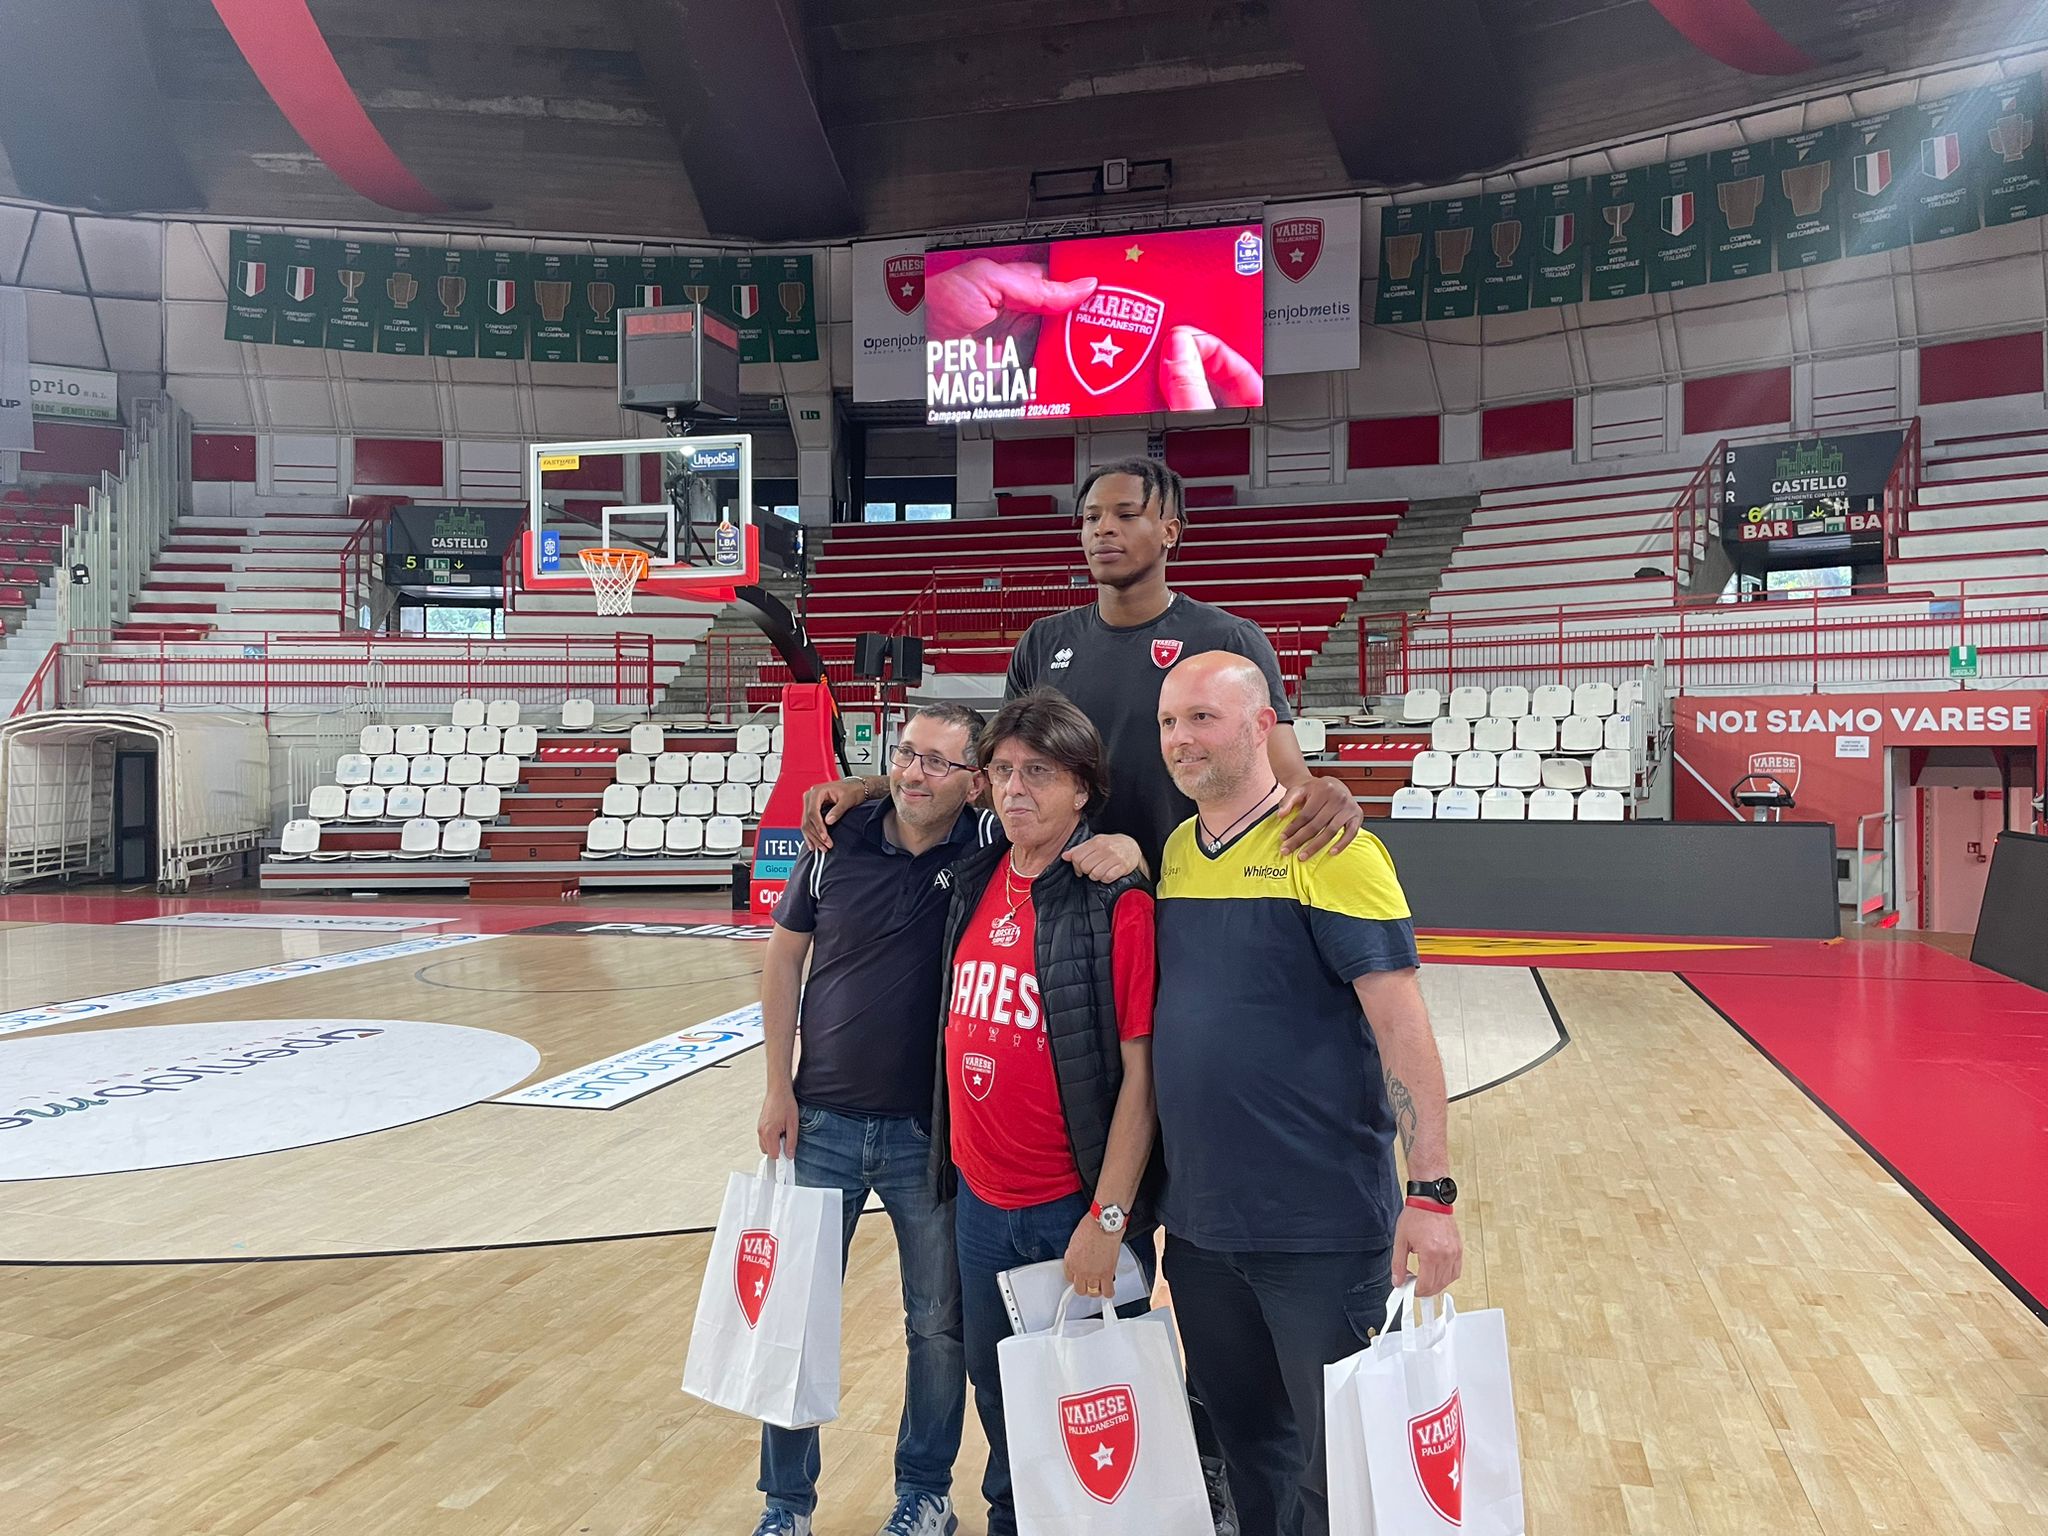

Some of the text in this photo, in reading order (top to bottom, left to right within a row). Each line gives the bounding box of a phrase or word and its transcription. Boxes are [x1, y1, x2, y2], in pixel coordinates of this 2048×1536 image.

[1275, 223, 1319, 237] VARESE
[1075, 313, 1153, 335] PALLACANESTRO
[927, 335, 1020, 373] PER LA
[927, 367, 1037, 406] MAGLIA!
[928, 403, 1071, 424] Campagna Abbonamenti 2024/2025
[693, 451, 735, 467] UnipolSai
[1725, 451, 1736, 503] BAR
[1772, 475, 1847, 493] CASTELLO
[1747, 506, 1762, 523] 6
[1743, 522, 1789, 540] BAR
[431, 537, 488, 549] CASTELLO
[718, 538, 737, 548] LBA
[406, 556, 417, 569] 5
[543, 556, 558, 564] FIP
[1696, 705, 2032, 733] NOI SIAMO VARESE
[1753, 757, 1796, 768] VARESE
[574, 767, 582, 777] D
[1364, 767, 1373, 777] D
[555, 800, 563, 809] C
[529, 848, 537, 857] B
[765, 839, 805, 856] ITELY
[765, 865, 787, 873] Gioca
[1244, 865, 1288, 879] Whirlpool
[950, 960, 1047, 1033] ARES
[965, 1056, 992, 1070] VARESE
[552, 1044, 716, 1101] acinque
[1064, 1395, 1128, 1425] VARESE
[1068, 1413, 1129, 1435] PALLACANESTRO
